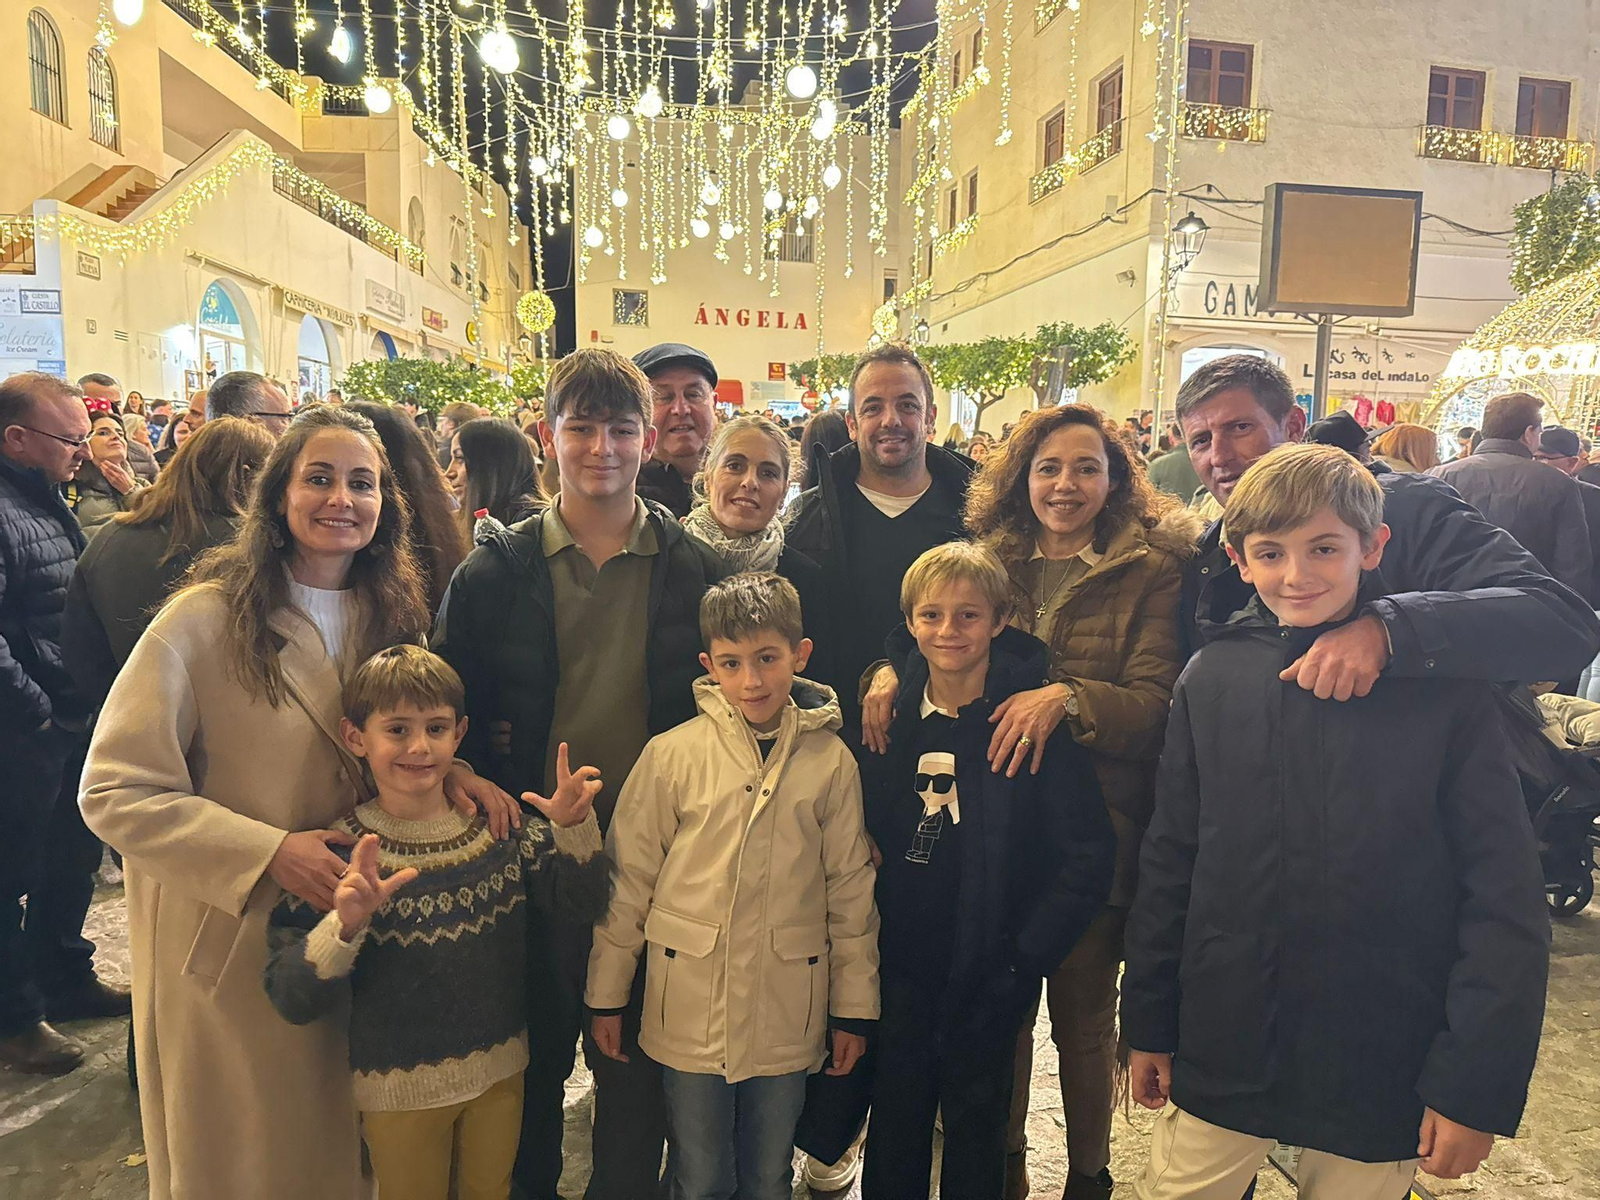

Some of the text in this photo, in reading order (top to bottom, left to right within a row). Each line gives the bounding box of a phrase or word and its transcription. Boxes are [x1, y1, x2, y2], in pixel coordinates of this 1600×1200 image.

[23, 301, 59, 310] EL CASTILLO
[694, 302, 807, 330] ÁNGELA
